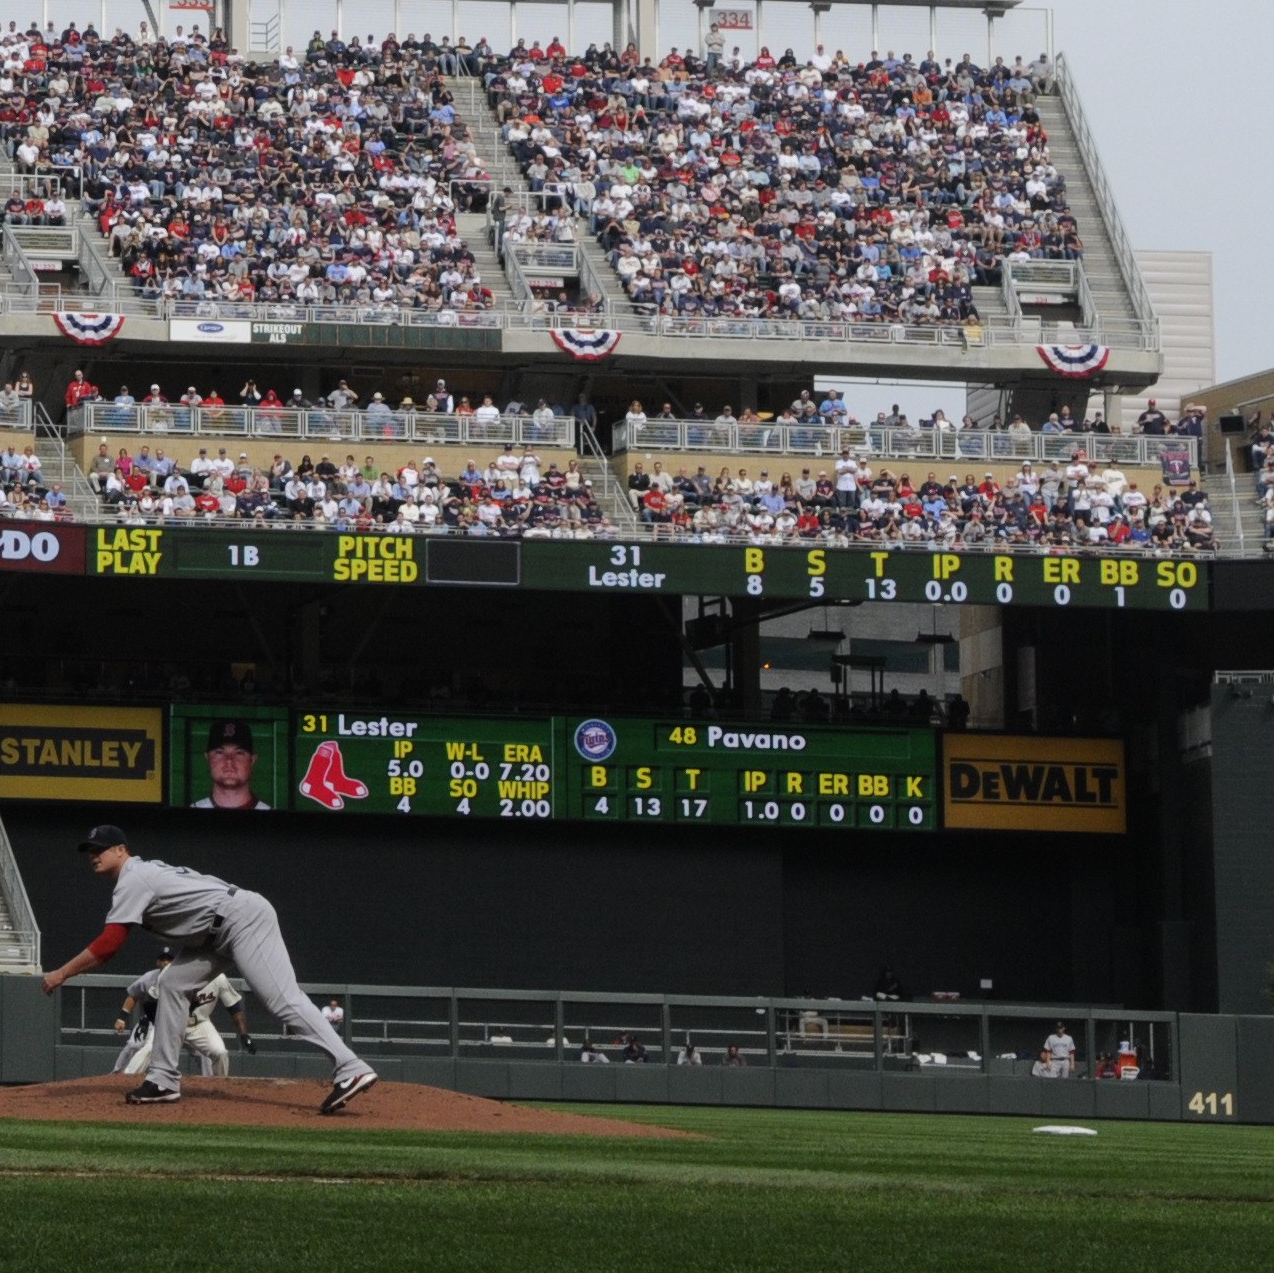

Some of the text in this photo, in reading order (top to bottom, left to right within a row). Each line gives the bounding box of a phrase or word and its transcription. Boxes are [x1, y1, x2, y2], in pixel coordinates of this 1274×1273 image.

[717, 11, 750, 27] 334
[253, 323, 302, 336] STRIKEOUT
[269, 333, 287, 343] ALS
[98, 529, 162, 554] LAST
[339, 536, 412, 563] PITCH
[97, 548, 162, 574] PLAY
[228, 545, 259, 565] 1B
[611, 545, 640, 566] 31
[334, 555, 417, 582] SPEED
[589, 566, 665, 587] Lester
[303, 714, 417, 737] 31 Lester
[669, 726, 805, 749] 48 Pavano
[1, 738, 141, 767] STANLEY
[395, 741, 542, 762] IP W-L ERA
[388, 760, 549, 783] 5.0 0-0 7.20
[390, 776, 549, 799] BB SO WHIP
[500, 799, 550, 817] 2.00
[1189, 1092, 1232, 1115] 411
